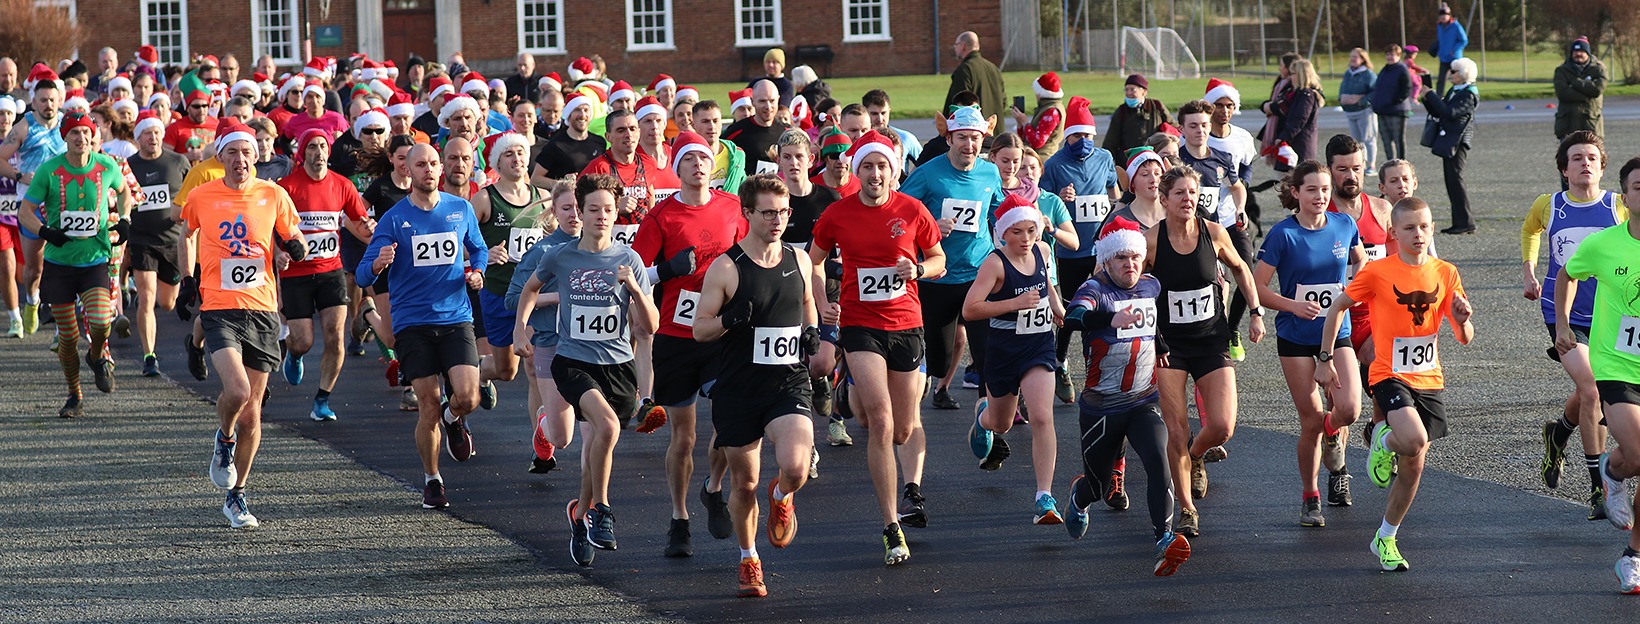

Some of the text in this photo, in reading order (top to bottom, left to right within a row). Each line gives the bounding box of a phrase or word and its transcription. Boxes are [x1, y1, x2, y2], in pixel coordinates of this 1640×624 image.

[952, 207, 976, 225] 72
[1080, 202, 1108, 217] 115
[63, 216, 96, 231] 222
[219, 214, 247, 240] 20
[308, 237, 337, 254] 240
[611, 231, 637, 245] 64
[416, 239, 456, 260] 219
[231, 265, 257, 284] 62
[1614, 266, 1628, 276] rbf
[862, 274, 904, 295] 245
[569, 293, 615, 303] canterbury
[1173, 294, 1211, 318] 117
[1304, 290, 1332, 309] 96
[575, 314, 618, 334] 140
[1023, 307, 1051, 328] 150
[760, 335, 799, 358] 160
[1398, 342, 1434, 366] 130
